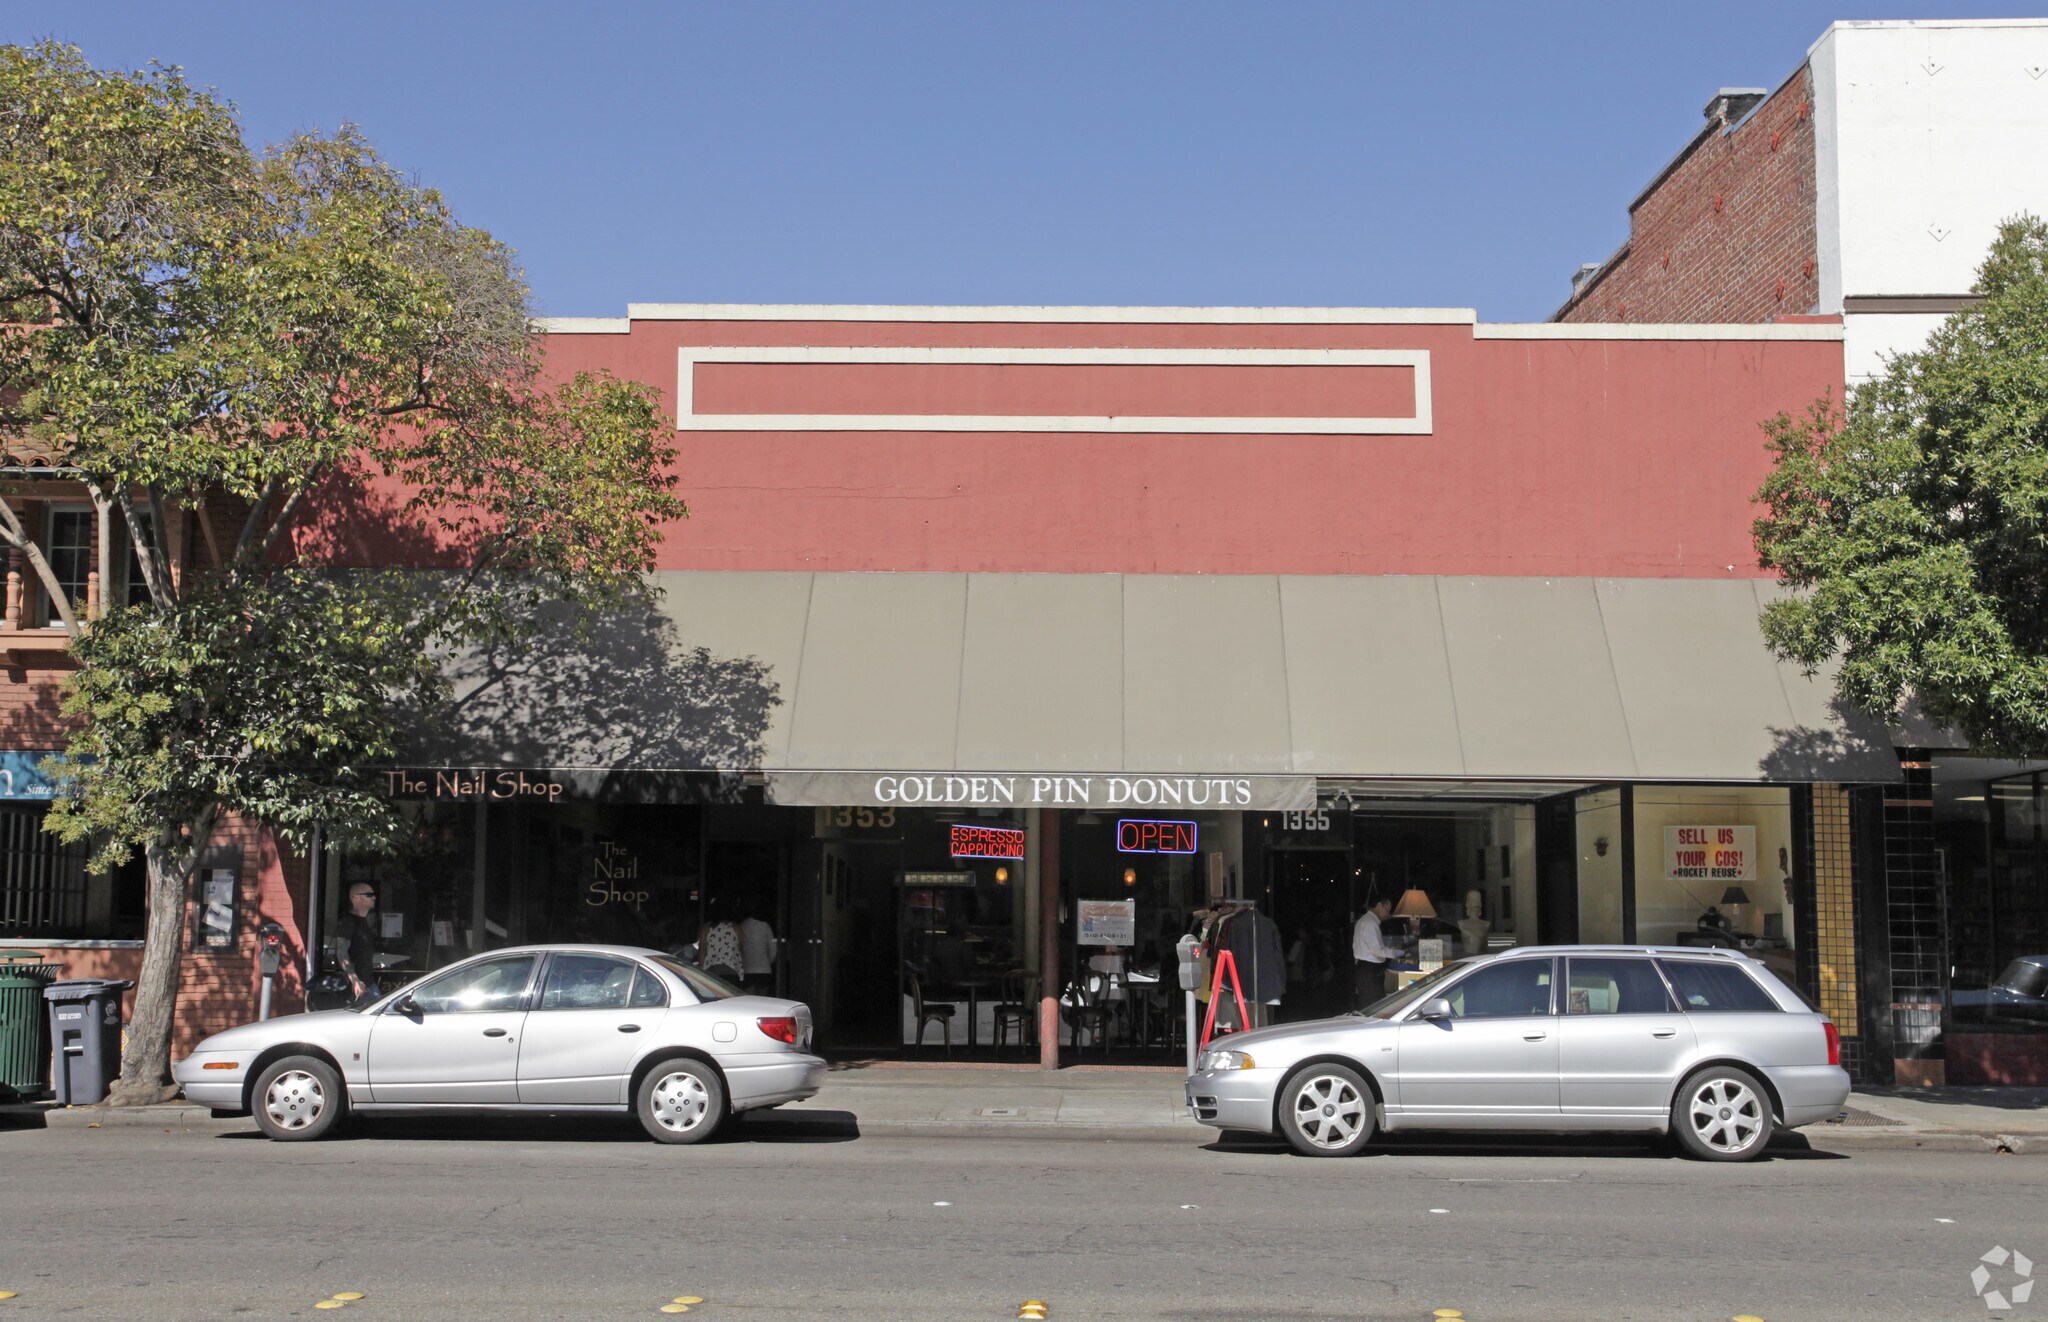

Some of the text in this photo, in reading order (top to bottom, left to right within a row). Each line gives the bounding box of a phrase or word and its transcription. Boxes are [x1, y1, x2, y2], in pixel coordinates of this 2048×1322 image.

[24, 783, 52, 795] Since
[384, 770, 563, 801] The Nail Shop
[875, 776, 1251, 804] GOLDEN PIN DONUTS
[823, 806, 896, 827] 1353
[1281, 808, 1330, 830] 1355
[951, 827, 1024, 844] ESPRESSO
[1120, 823, 1194, 850] OPEN
[1679, 828, 1734, 844] SELL US
[600, 841, 628, 859] The
[951, 841, 1024, 857] CAPPUCCINO
[1676, 850, 1743, 866] YOUR CDS!
[594, 857, 637, 879] Nail
[1678, 868, 1737, 877] ROCKET REUSE
[586, 882, 649, 911] Shop
